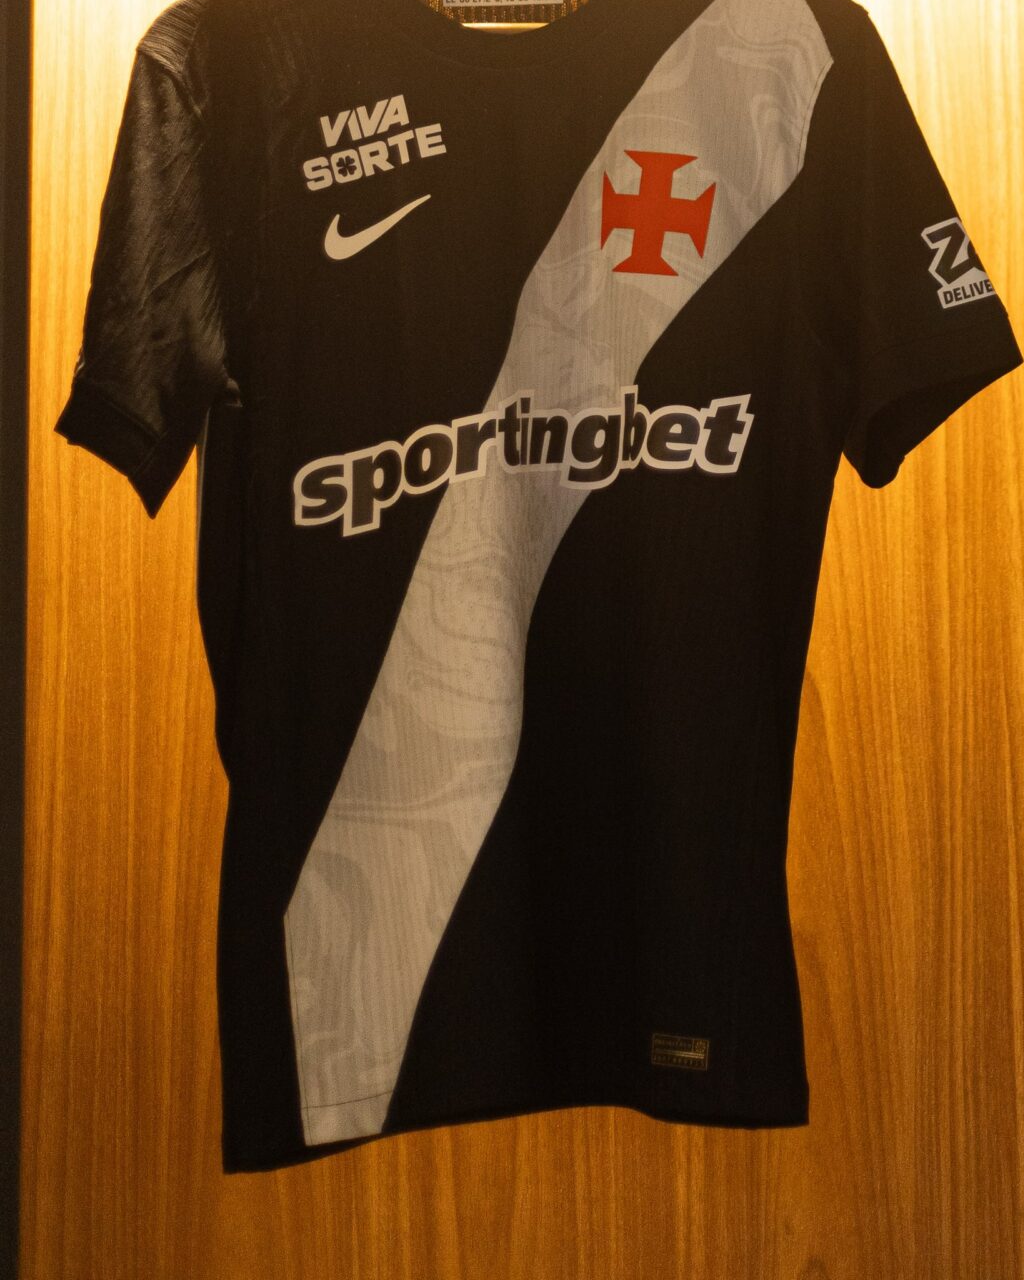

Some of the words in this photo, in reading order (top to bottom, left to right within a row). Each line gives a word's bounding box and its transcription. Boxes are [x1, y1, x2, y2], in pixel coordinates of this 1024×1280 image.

[320, 94, 409, 148] VIVA
[303, 123, 447, 191] SORTE
[943, 280, 994, 305] DELIVE
[294, 385, 755, 538] sportingbet
